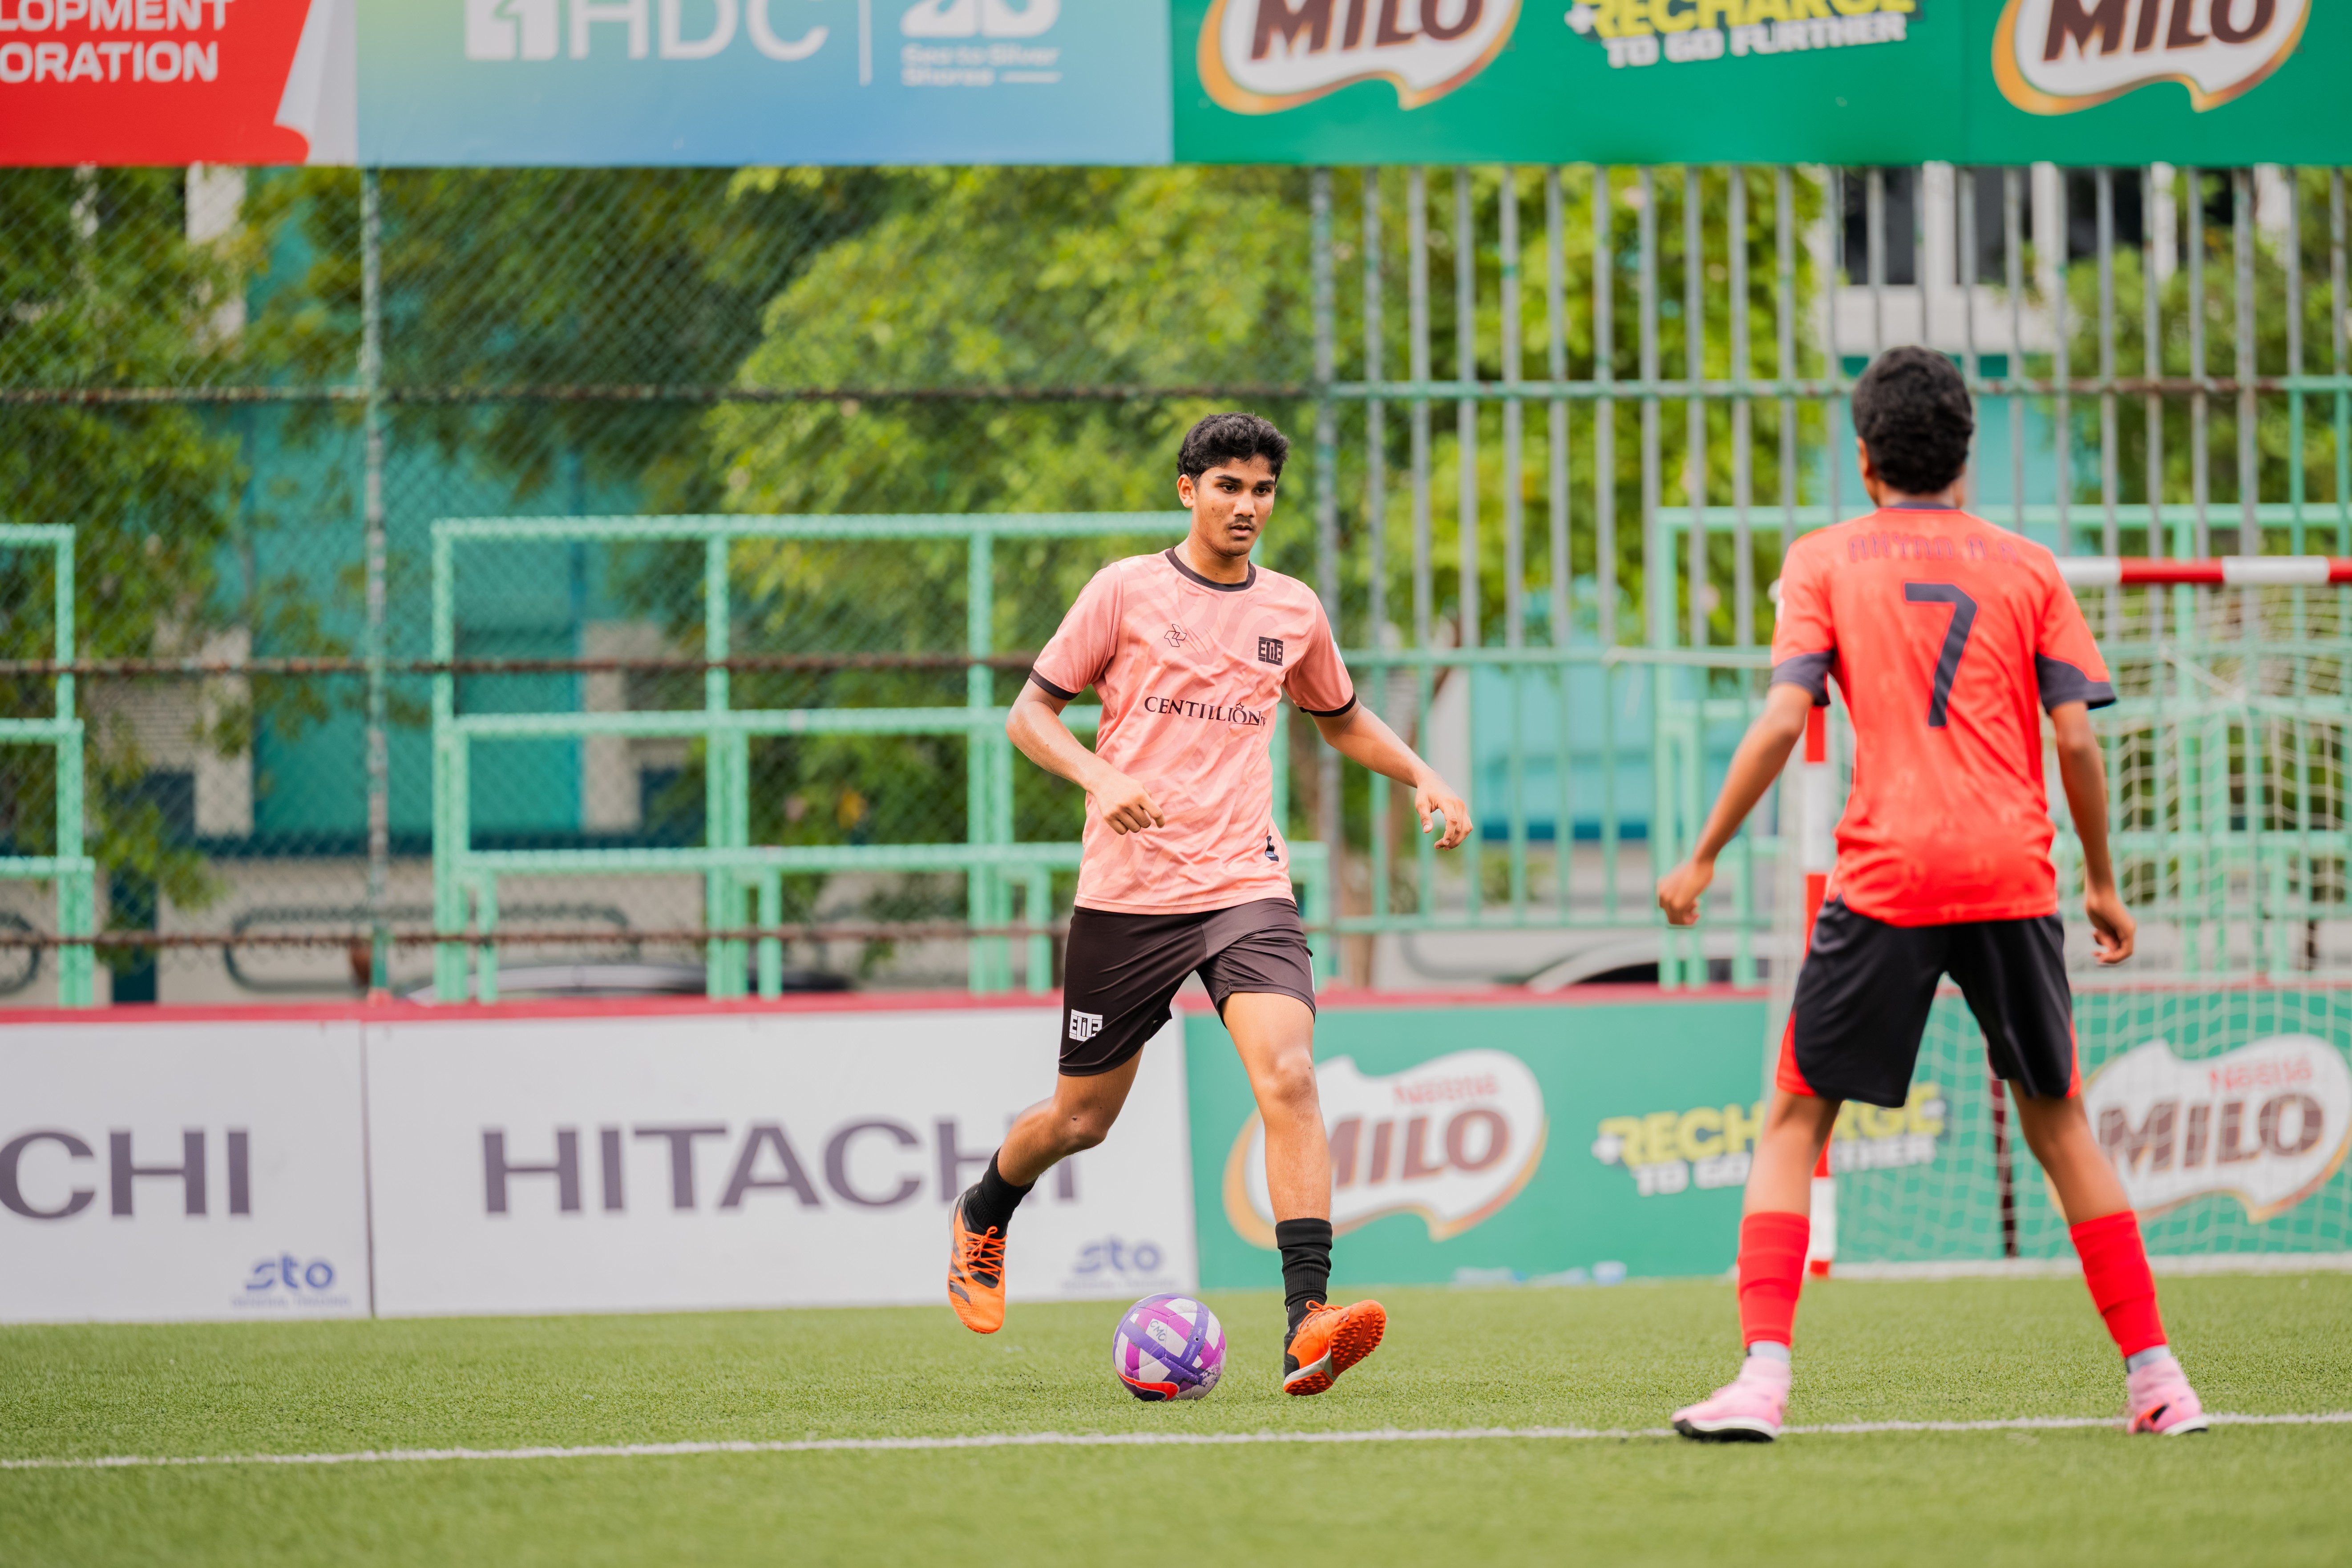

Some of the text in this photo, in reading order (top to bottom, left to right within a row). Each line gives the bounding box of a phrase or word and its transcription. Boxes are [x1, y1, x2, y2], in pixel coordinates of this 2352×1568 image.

[568, 0, 829, 61] HDC
[1251, 0, 1484, 60] MILO
[1573, 0, 1916, 38] RECHA
[1603, 12, 1907, 69] TO GO FURTHER
[2042, 0, 2276, 61] MILO
[0, 41, 218, 83] ORATION
[1905, 582, 1977, 727] 7
[1597, 1083, 1945, 1171] RECHRGE
[2098, 1093, 2324, 1172] MILO
[0, 1131, 250, 1219] CHI
[1629, 1159, 1690, 1197] TO
[246, 1254, 334, 1290] sto
